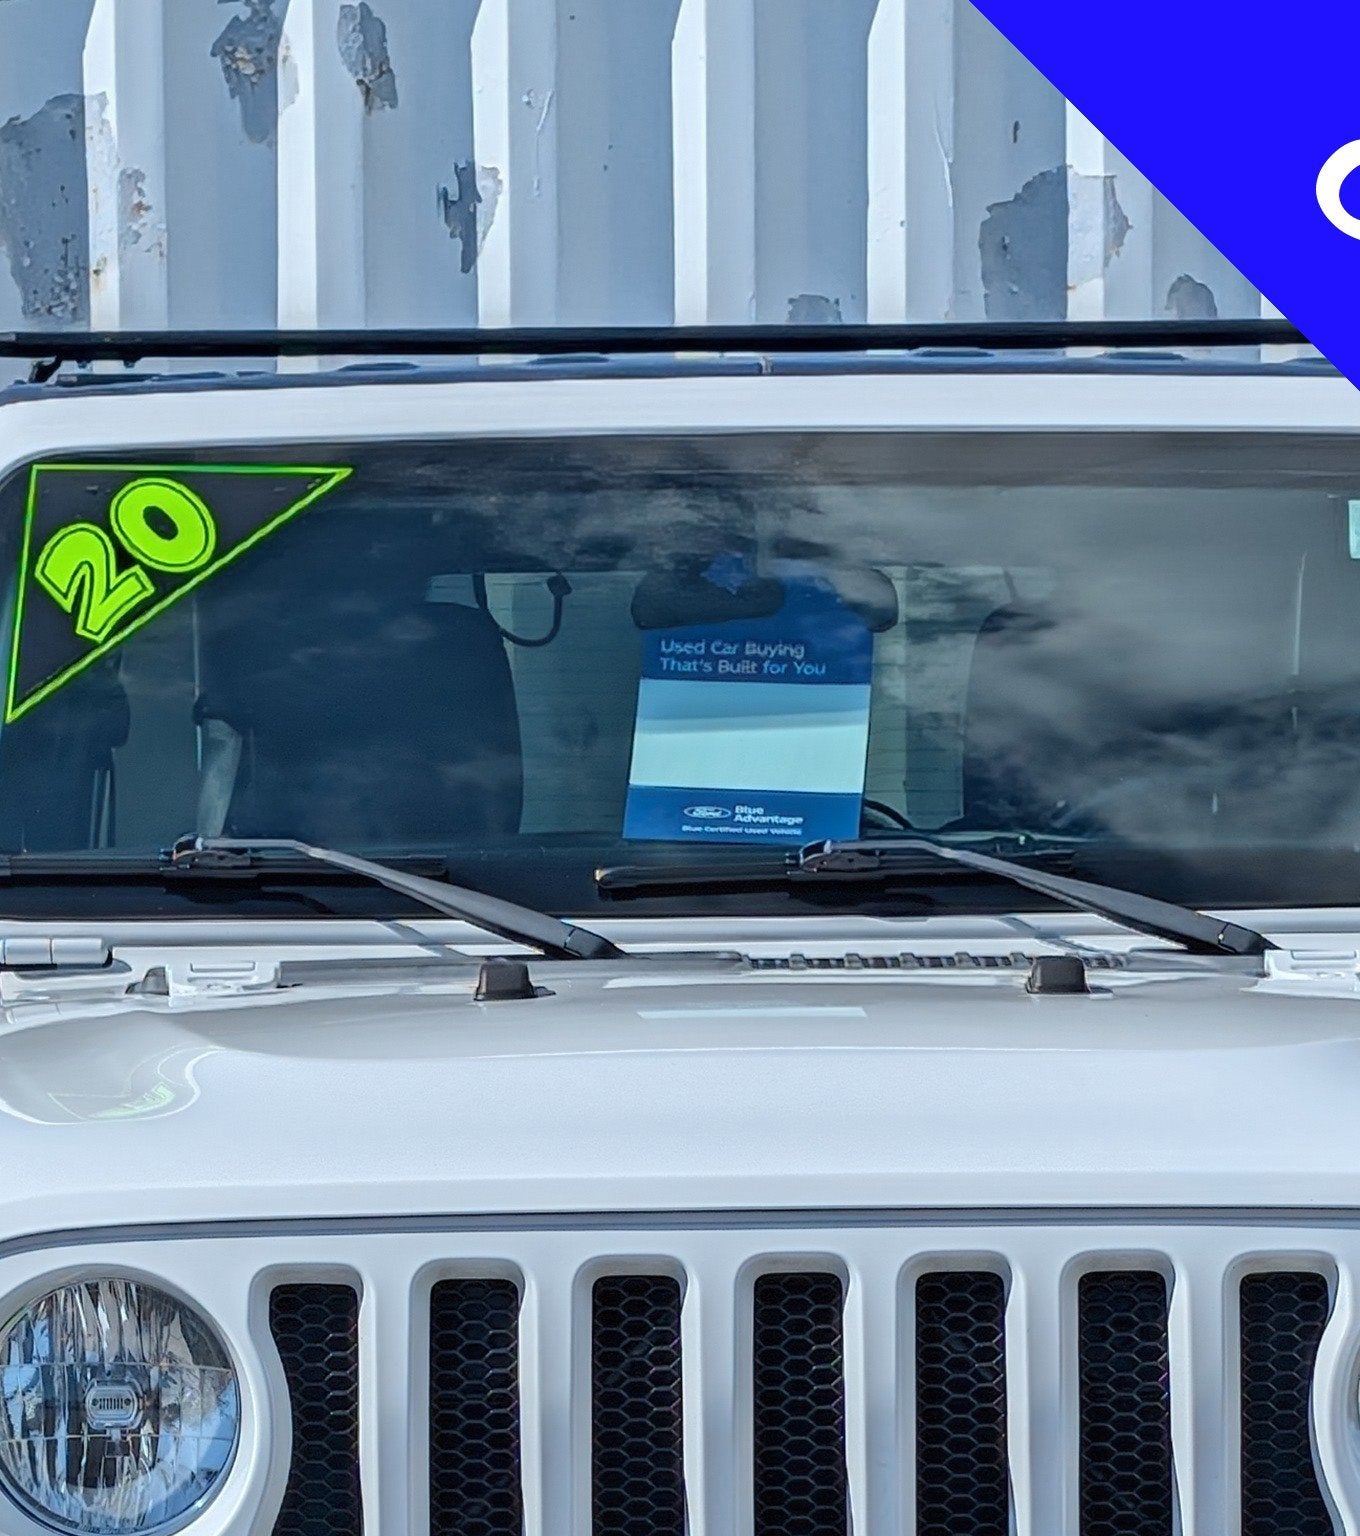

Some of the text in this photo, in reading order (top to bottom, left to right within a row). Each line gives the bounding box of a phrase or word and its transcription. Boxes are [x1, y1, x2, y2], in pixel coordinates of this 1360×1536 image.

[35, 477, 216, 644] 20
[660, 639, 805, 660] Used Car Buying
[660, 657, 826, 675] That's Built for You
[734, 805, 764, 815] Blue
[733, 814, 803, 826] Advantage
